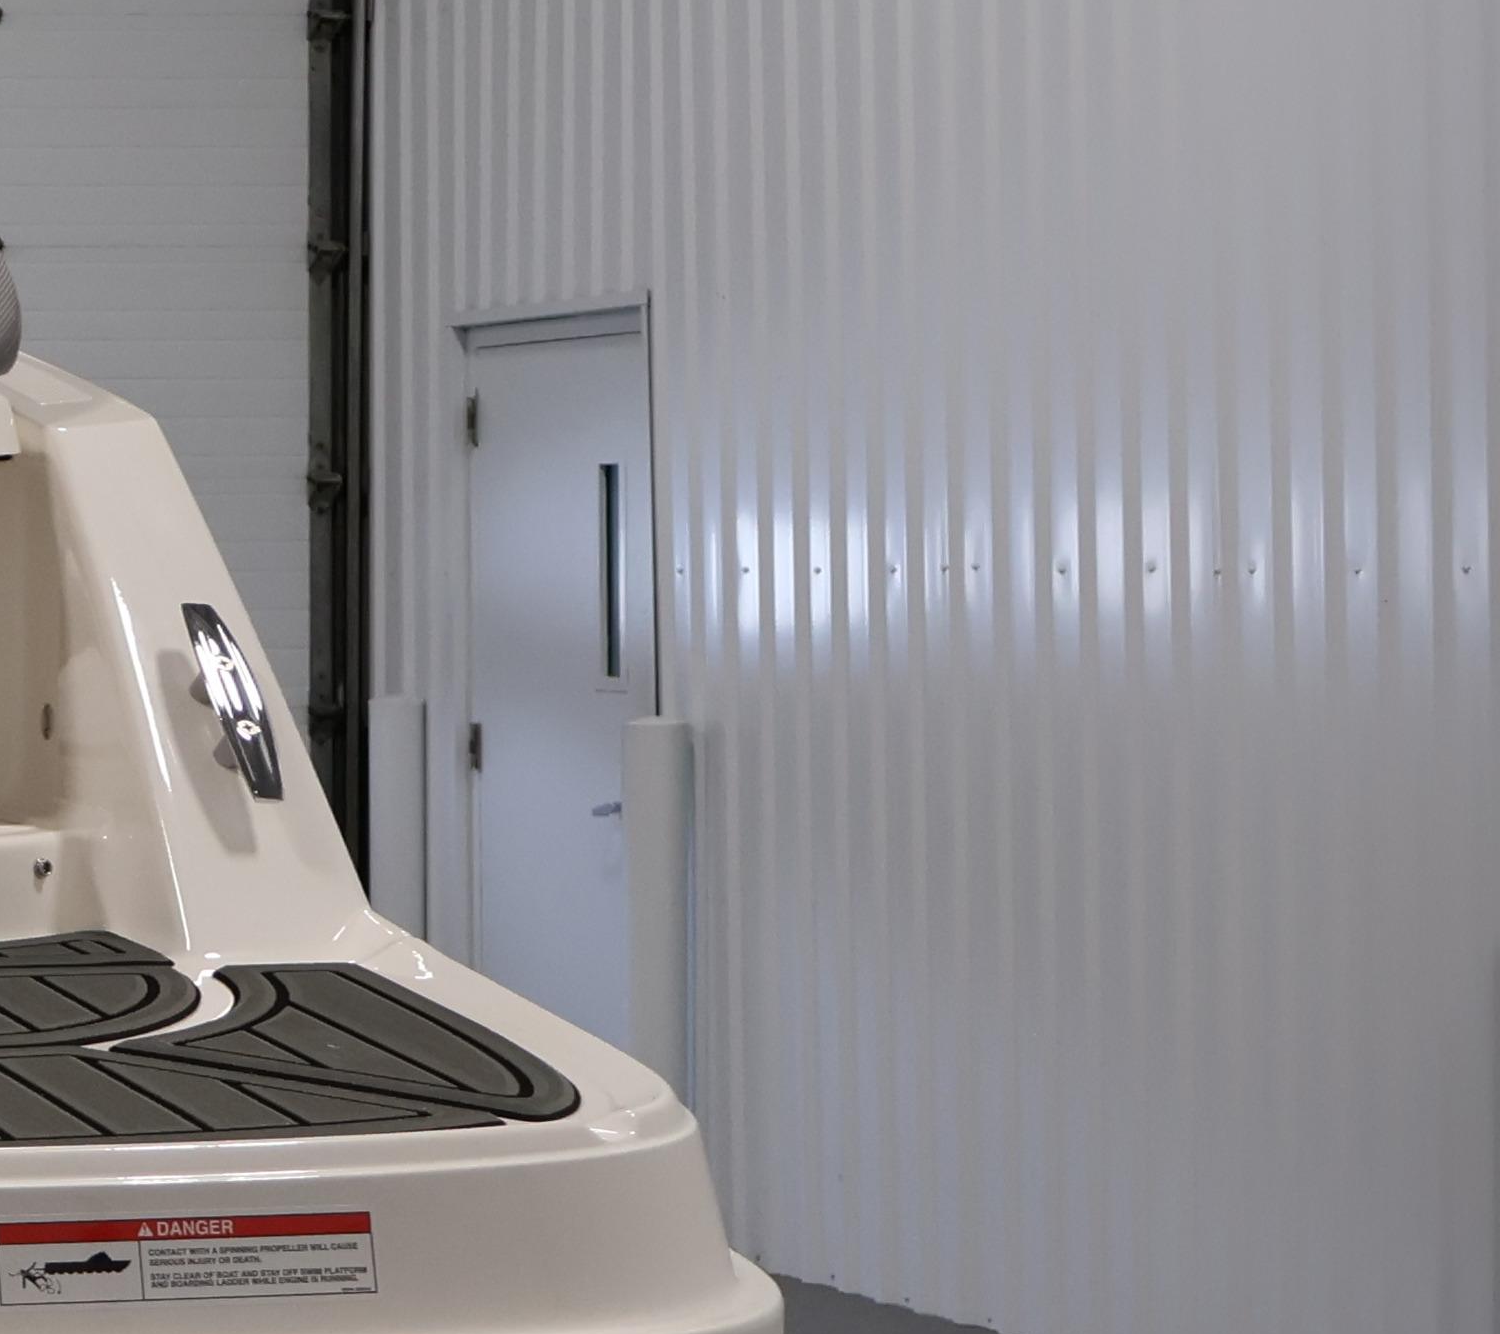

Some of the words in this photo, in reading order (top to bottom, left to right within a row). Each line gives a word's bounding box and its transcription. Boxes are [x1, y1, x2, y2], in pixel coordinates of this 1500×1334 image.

[157, 1219, 233, 1236] DANGER
[330, 1242, 358, 1250] CAUSE
[149, 1258, 185, 1266] SERIOUS
[173, 1272, 201, 1280] CLEAR
